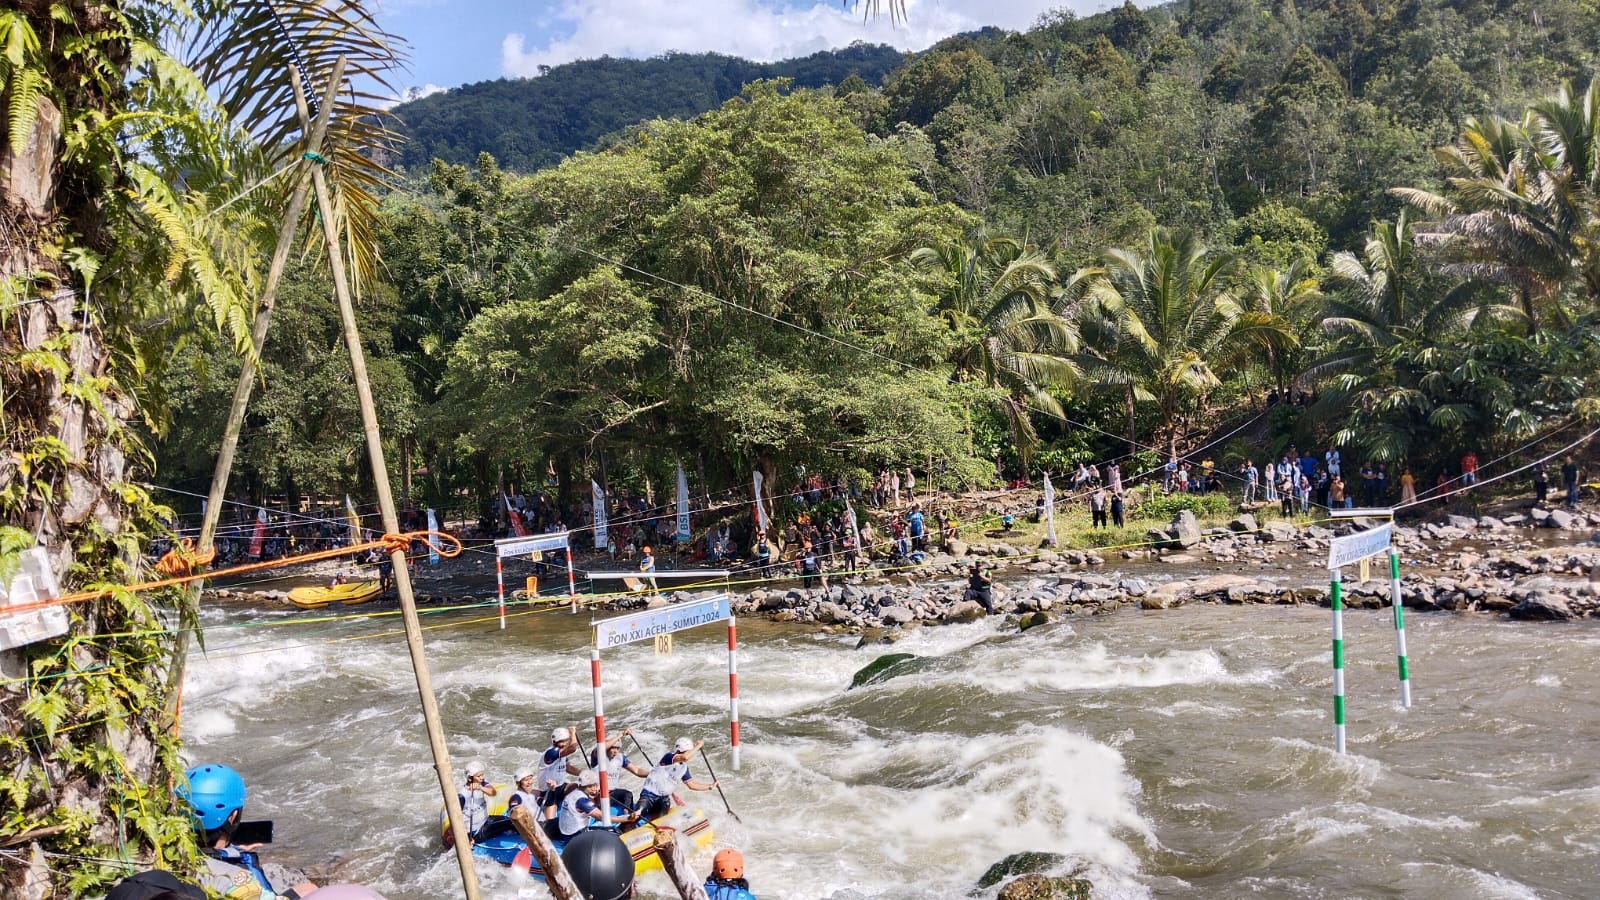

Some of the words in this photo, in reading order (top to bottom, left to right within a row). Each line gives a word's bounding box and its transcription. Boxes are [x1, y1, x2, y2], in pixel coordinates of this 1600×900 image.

[679, 514, 689, 530] BSI
[608, 634, 628, 646] PON
[629, 629, 643, 640] XXI
[645, 624, 667, 638] ACEH
[673, 615, 700, 631] SUMUT
[702, 611, 720, 623] 2024
[658, 635, 669, 653] 08
